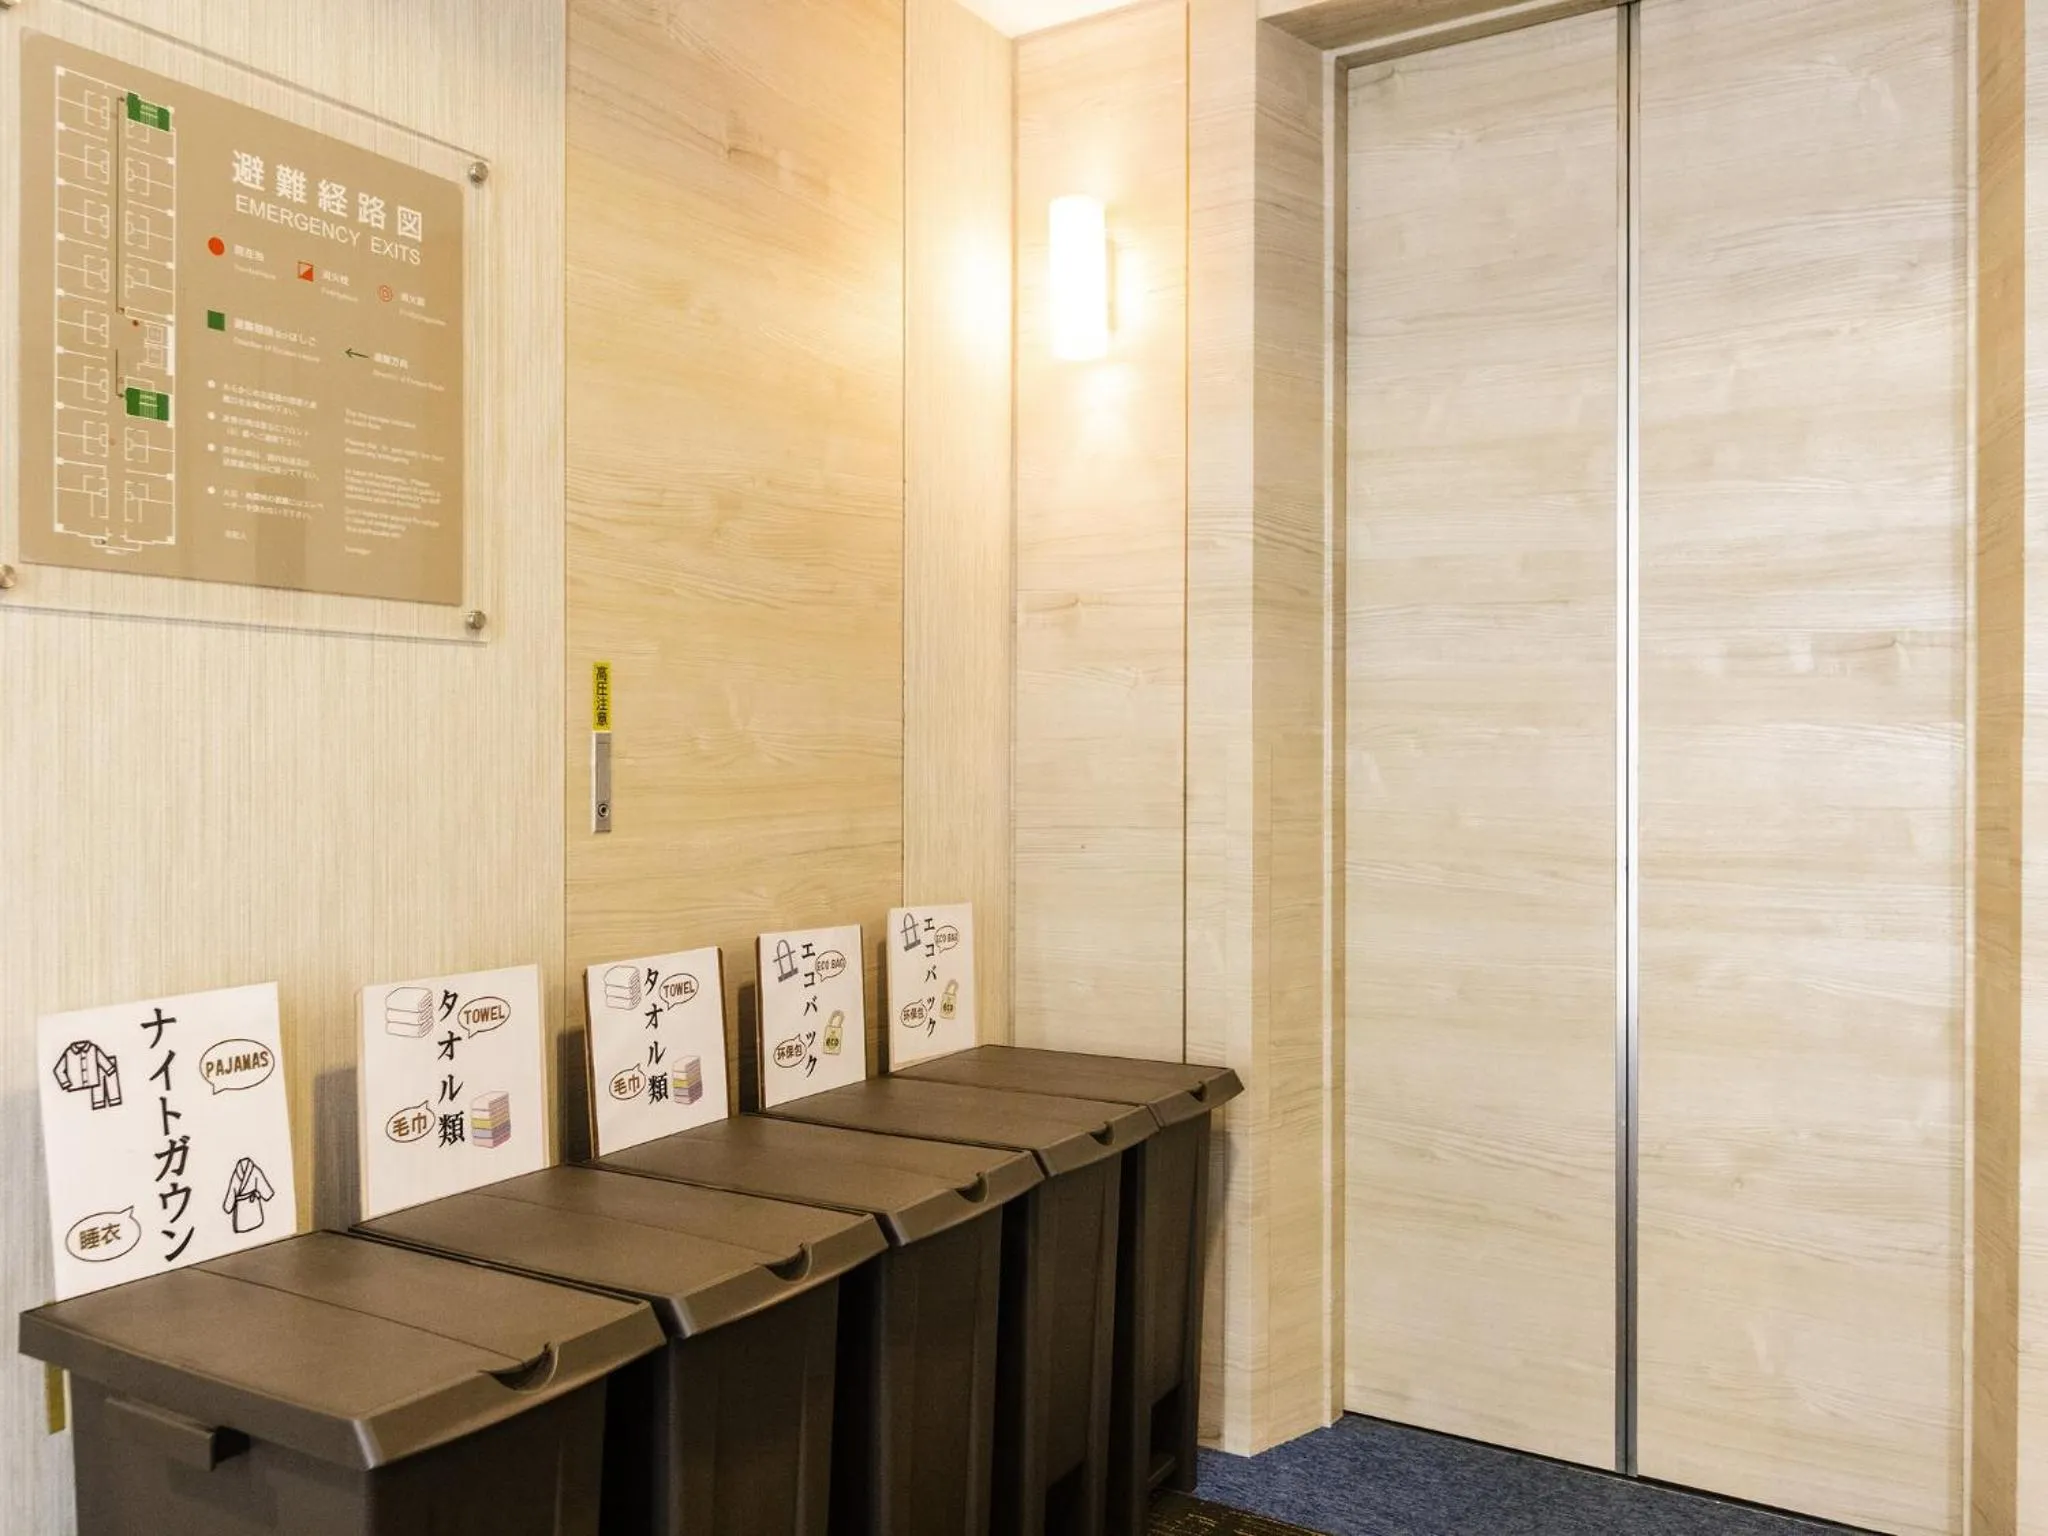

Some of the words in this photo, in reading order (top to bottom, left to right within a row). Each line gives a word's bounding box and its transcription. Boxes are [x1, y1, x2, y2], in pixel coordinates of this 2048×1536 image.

[232, 150, 423, 243] 避難経路図
[235, 193, 361, 248] EMERGENCY
[370, 236, 422, 266] EXITS
[596, 666, 609, 727] 高圧注意
[817, 959, 829, 971] ECO
[830, 958, 846, 969] BAG
[662, 981, 695, 998] TOWEL
[463, 1003, 506, 1025] TOWEL
[643, 966, 669, 1106] タオル類
[205, 1049, 270, 1080] PAJAMAS
[436, 989, 466, 1149] タオル類
[612, 1078, 641, 1095] 毛巾
[139, 1007, 195, 1263] ナイトガウン
[391, 1113, 428, 1136] 毛巾
[78, 1222, 123, 1251] 睡衣
